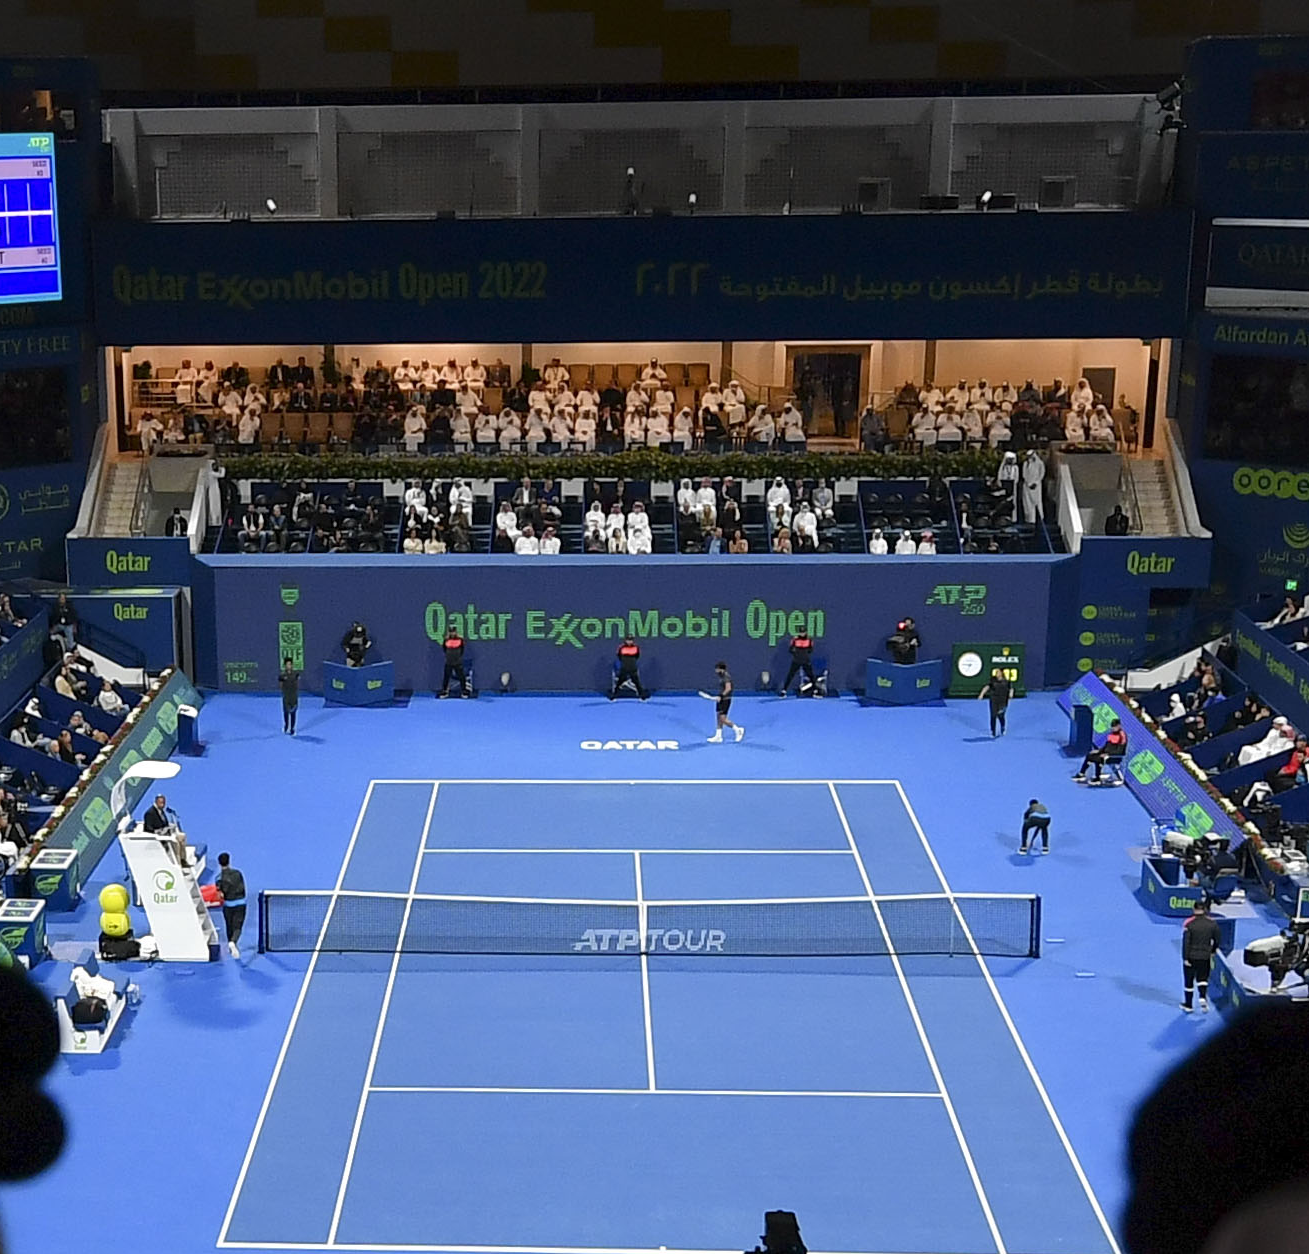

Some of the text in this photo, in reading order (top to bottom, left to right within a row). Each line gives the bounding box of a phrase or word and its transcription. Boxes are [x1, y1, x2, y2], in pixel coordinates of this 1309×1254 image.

[113, 260, 547, 309] Qatar ExxonMobil Open 2022
[719, 270, 837, 302] المفتوحة
[1024, 266, 1082, 299] قطر
[1086, 271, 1165, 295] بطولة
[27, 335, 71, 353] FREE
[1213, 324, 1289, 345] Alfardan
[106, 550, 152, 574] Qatar
[1126, 550, 1176, 575] Qatar
[925, 585, 988, 605] ATP
[113, 602, 149, 621] Qatar
[960, 604, 986, 615] 250
[424, 599, 826, 648] Qatar ExxonMobil Open
[580, 740, 679, 751] QATAR
[153, 892, 179, 904] Qatar
[1169, 896, 1196, 909] Qatar
[572, 929, 727, 952] ATP TOUR
